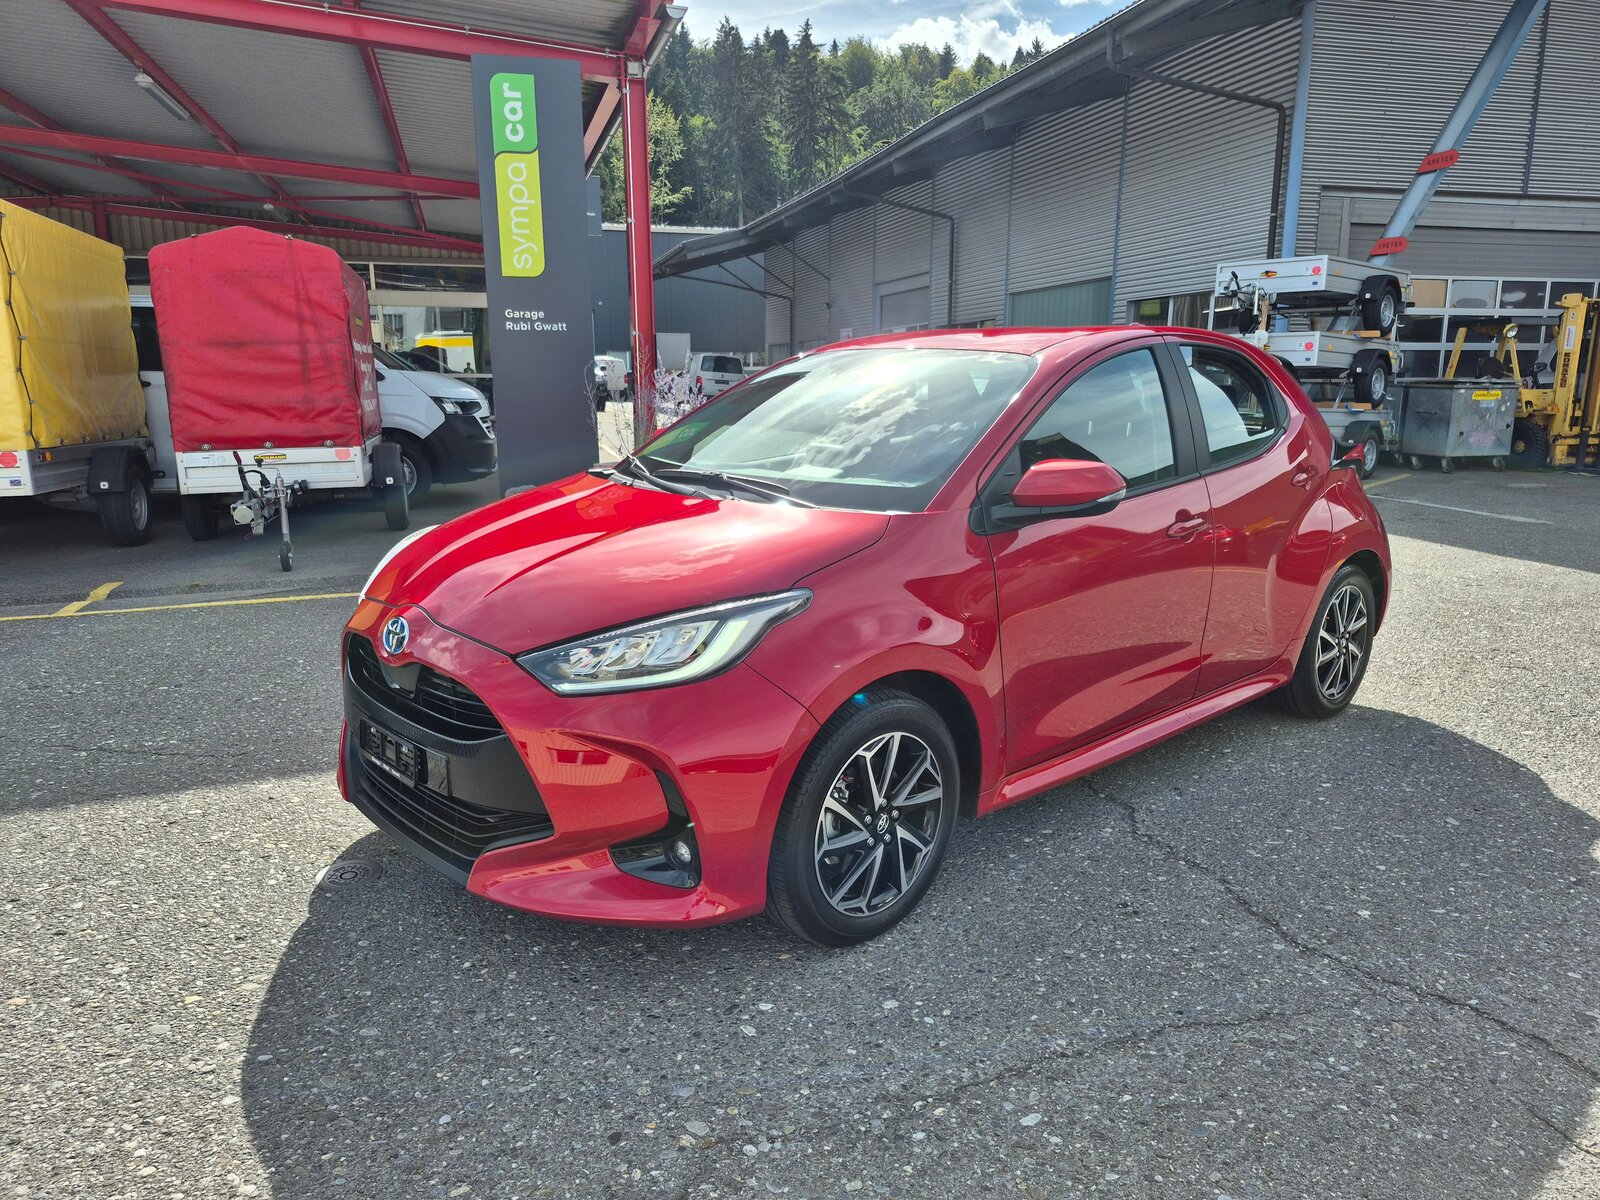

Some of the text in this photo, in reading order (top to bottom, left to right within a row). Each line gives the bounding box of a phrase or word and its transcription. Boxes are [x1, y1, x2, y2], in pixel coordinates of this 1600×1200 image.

[502, 82, 538, 269] sympa car
[505, 309, 545, 320] Garage
[505, 321, 567, 331] Rubi Gwatt
